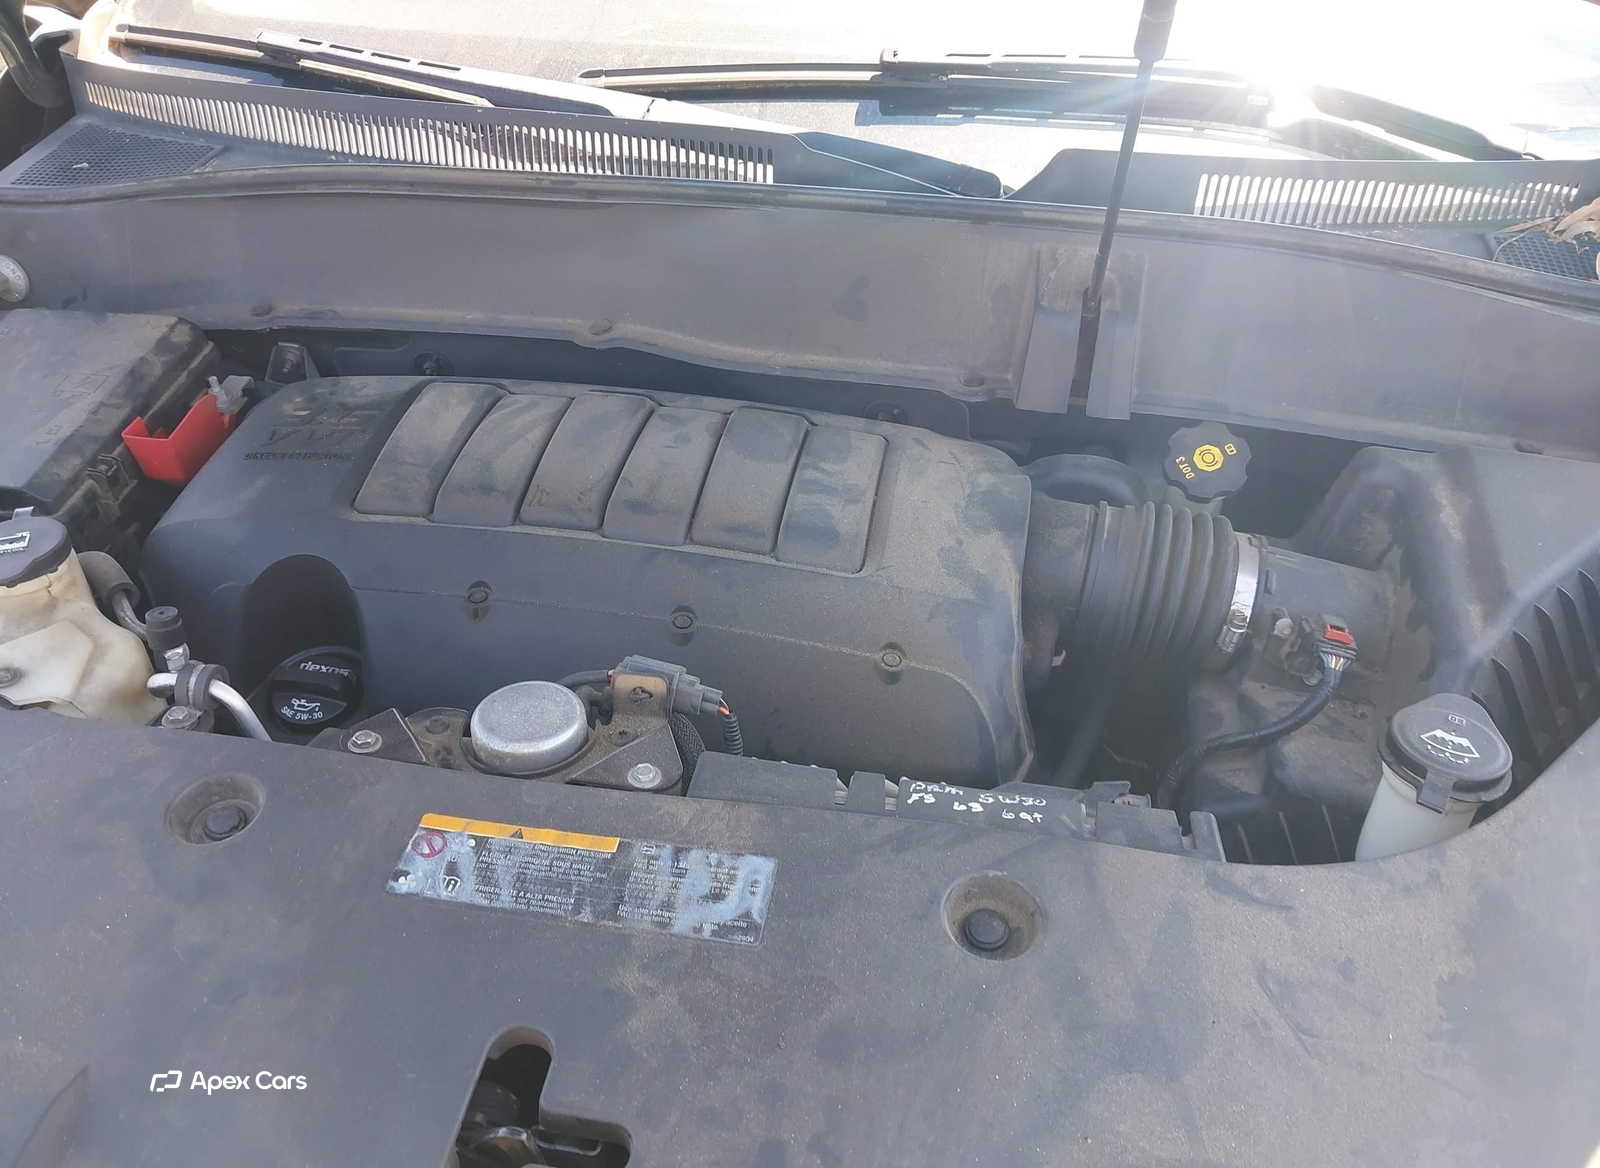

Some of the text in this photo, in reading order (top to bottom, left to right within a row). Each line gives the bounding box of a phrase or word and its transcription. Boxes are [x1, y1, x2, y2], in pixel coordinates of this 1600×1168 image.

[1175, 456, 1195, 479] DOT 3
[281, 706, 324, 721] SAE 5W-30
